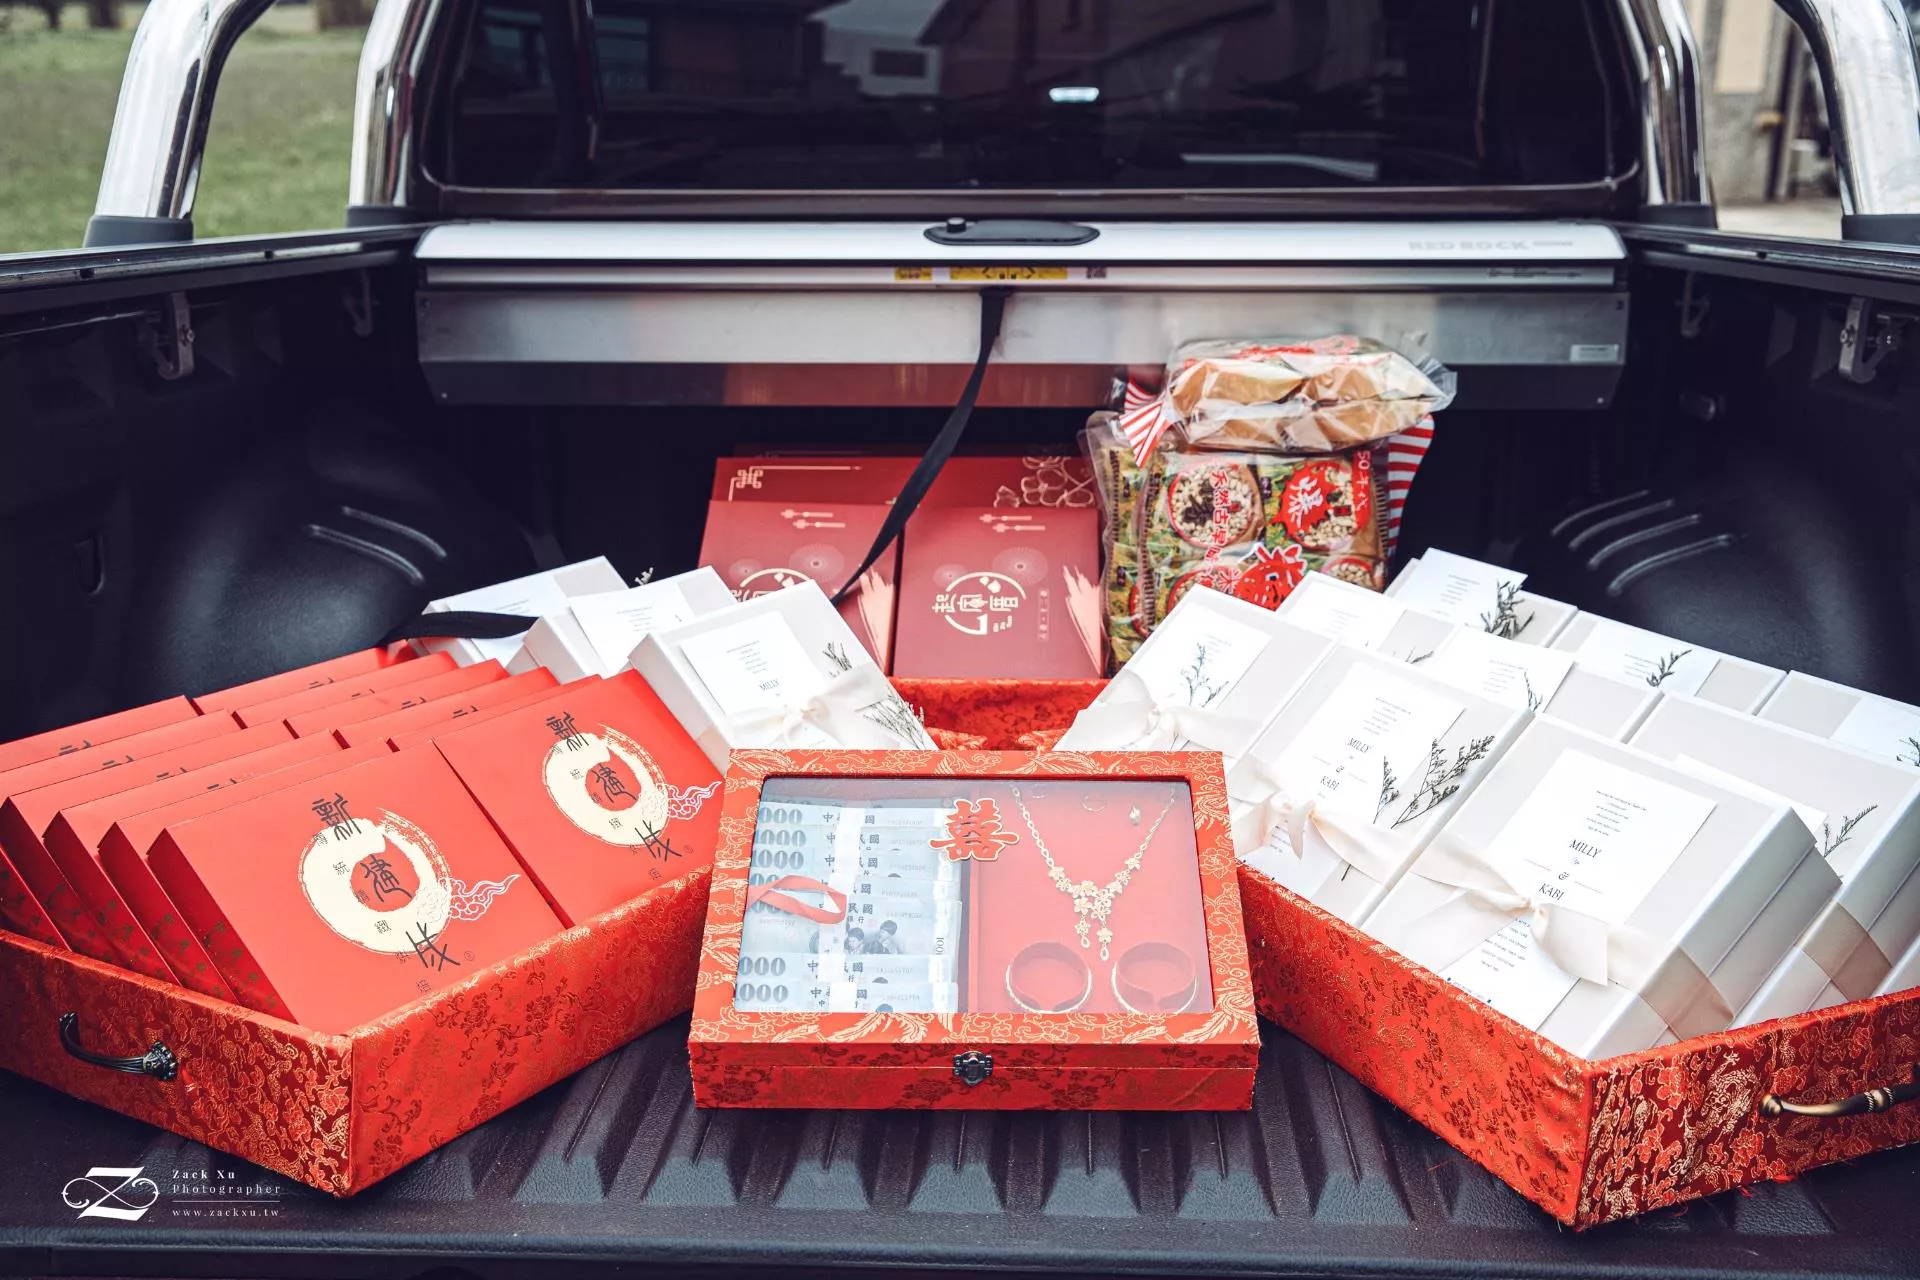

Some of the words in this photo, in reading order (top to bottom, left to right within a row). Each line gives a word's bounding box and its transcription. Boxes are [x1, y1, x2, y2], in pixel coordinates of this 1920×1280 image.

[759, 679, 780, 691] MILLY
[1346, 737, 1372, 754] MILLY
[1569, 838, 1602, 859] MILLY
[1538, 882, 1565, 901] KABI
